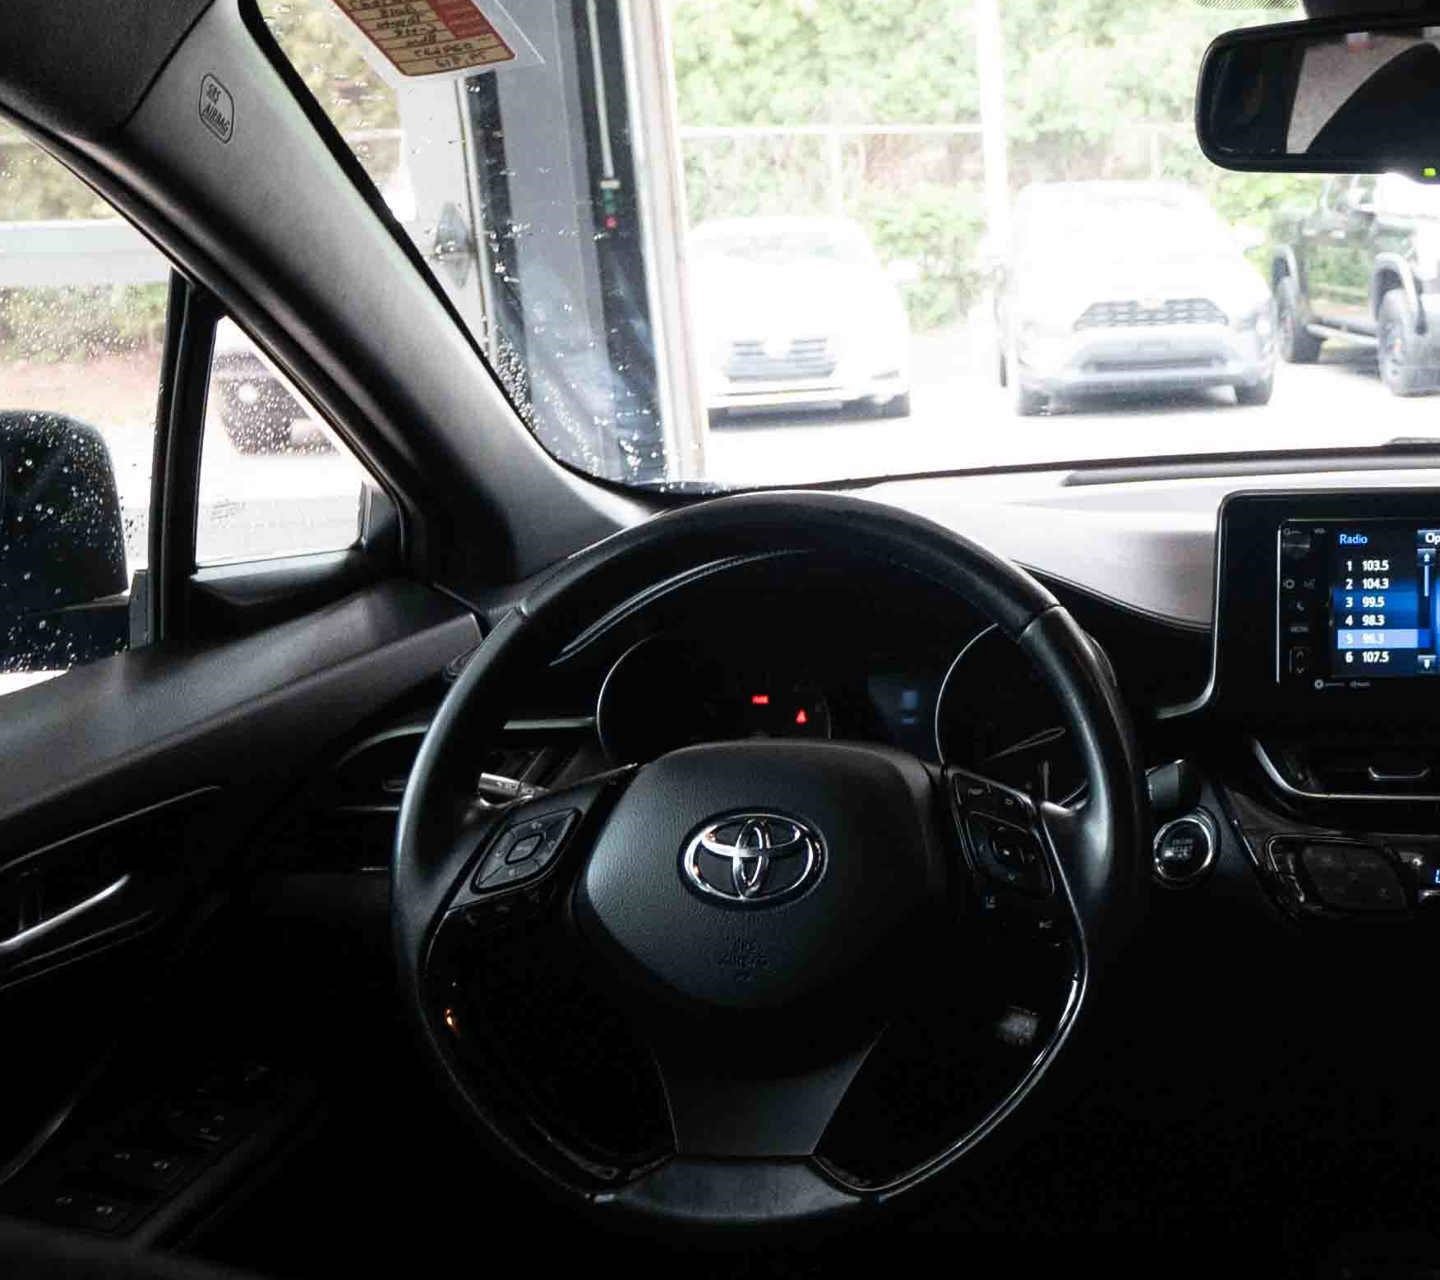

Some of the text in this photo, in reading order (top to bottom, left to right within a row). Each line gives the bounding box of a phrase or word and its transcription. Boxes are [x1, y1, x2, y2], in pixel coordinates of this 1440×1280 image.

[1339, 533, 1369, 545] Radio
[1345, 560, 1390, 572] 1 103.5
[1345, 578, 1390, 590] 2 104.3
[1345, 596, 1386, 608] 3 99.5
[1344, 614, 1386, 627] 4 98.3
[1344, 651, 1390, 664] 6 107.5
